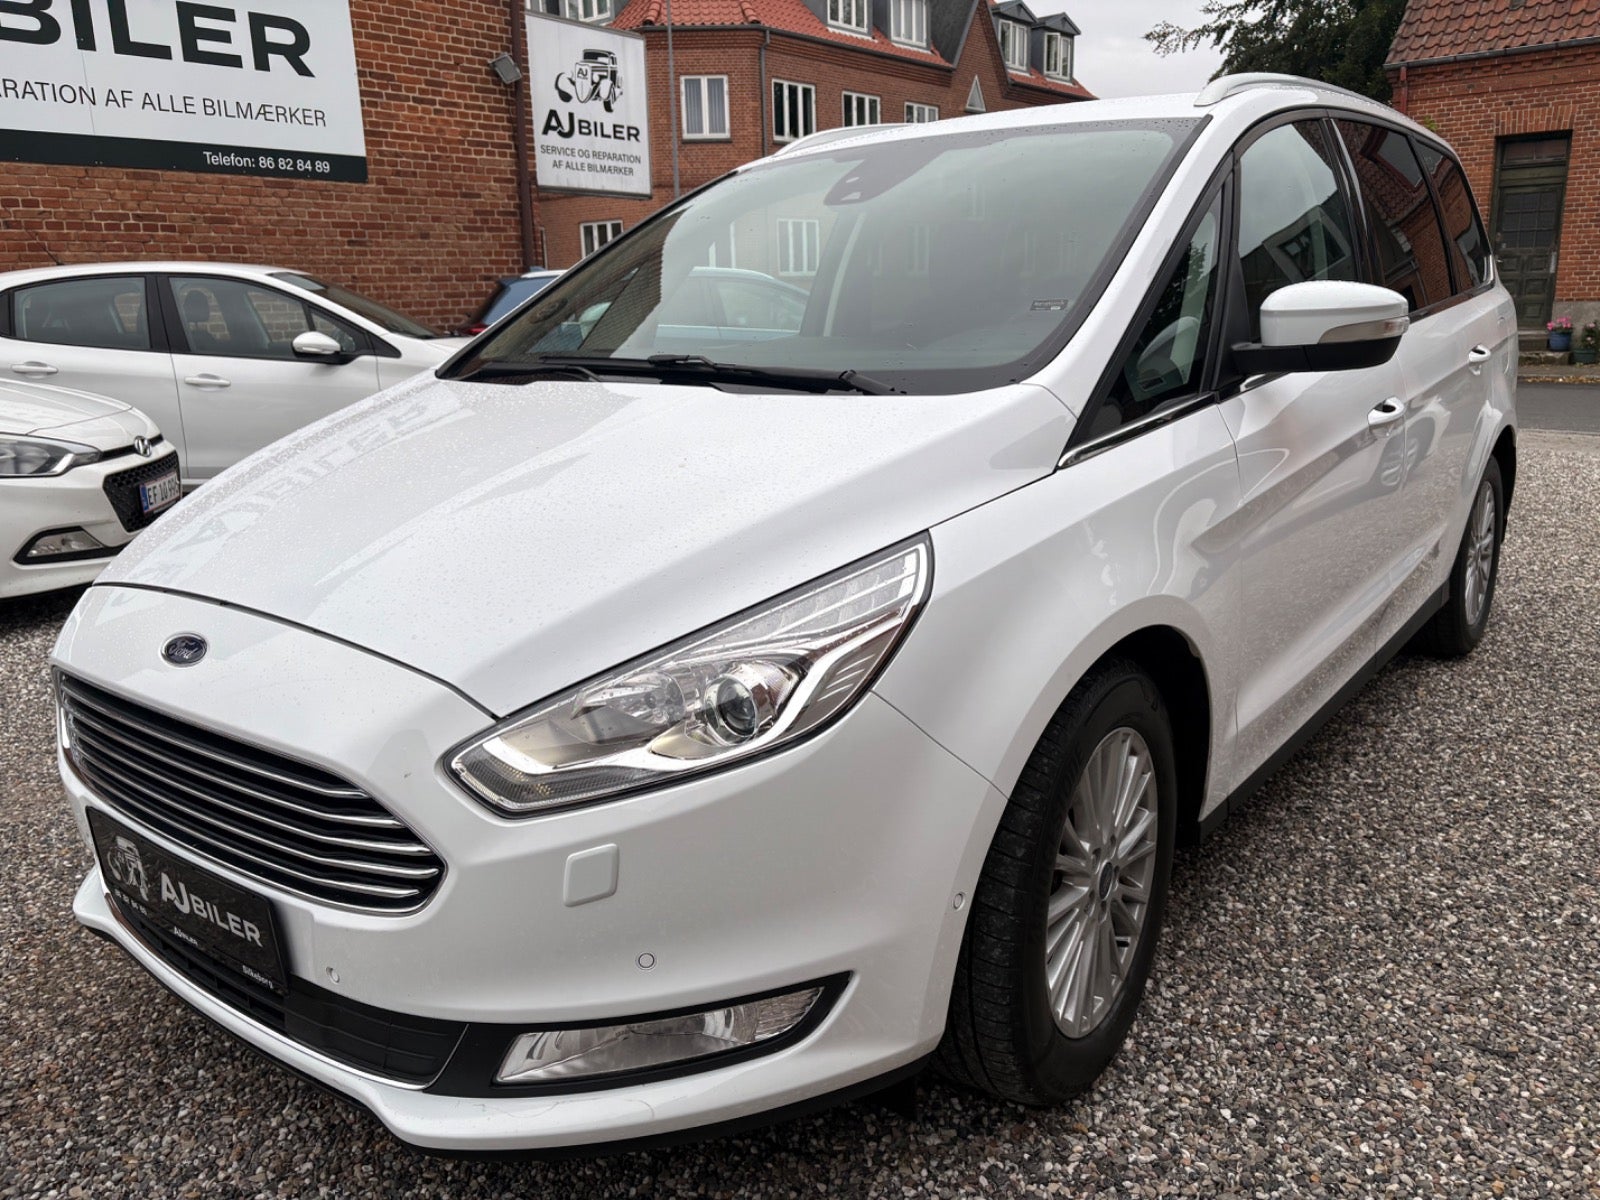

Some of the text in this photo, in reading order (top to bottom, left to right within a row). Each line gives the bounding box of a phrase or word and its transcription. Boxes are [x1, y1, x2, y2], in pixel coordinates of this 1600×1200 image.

[0, 78, 328, 128] RATION AF ALLE BILMÆRKER
[203, 151, 330, 173] Telefon: 86 82 84 89
[540, 144, 641, 164] SERVICE OG REPARATION
[552, 159, 634, 176] AF ALLE BILMÆRKER
